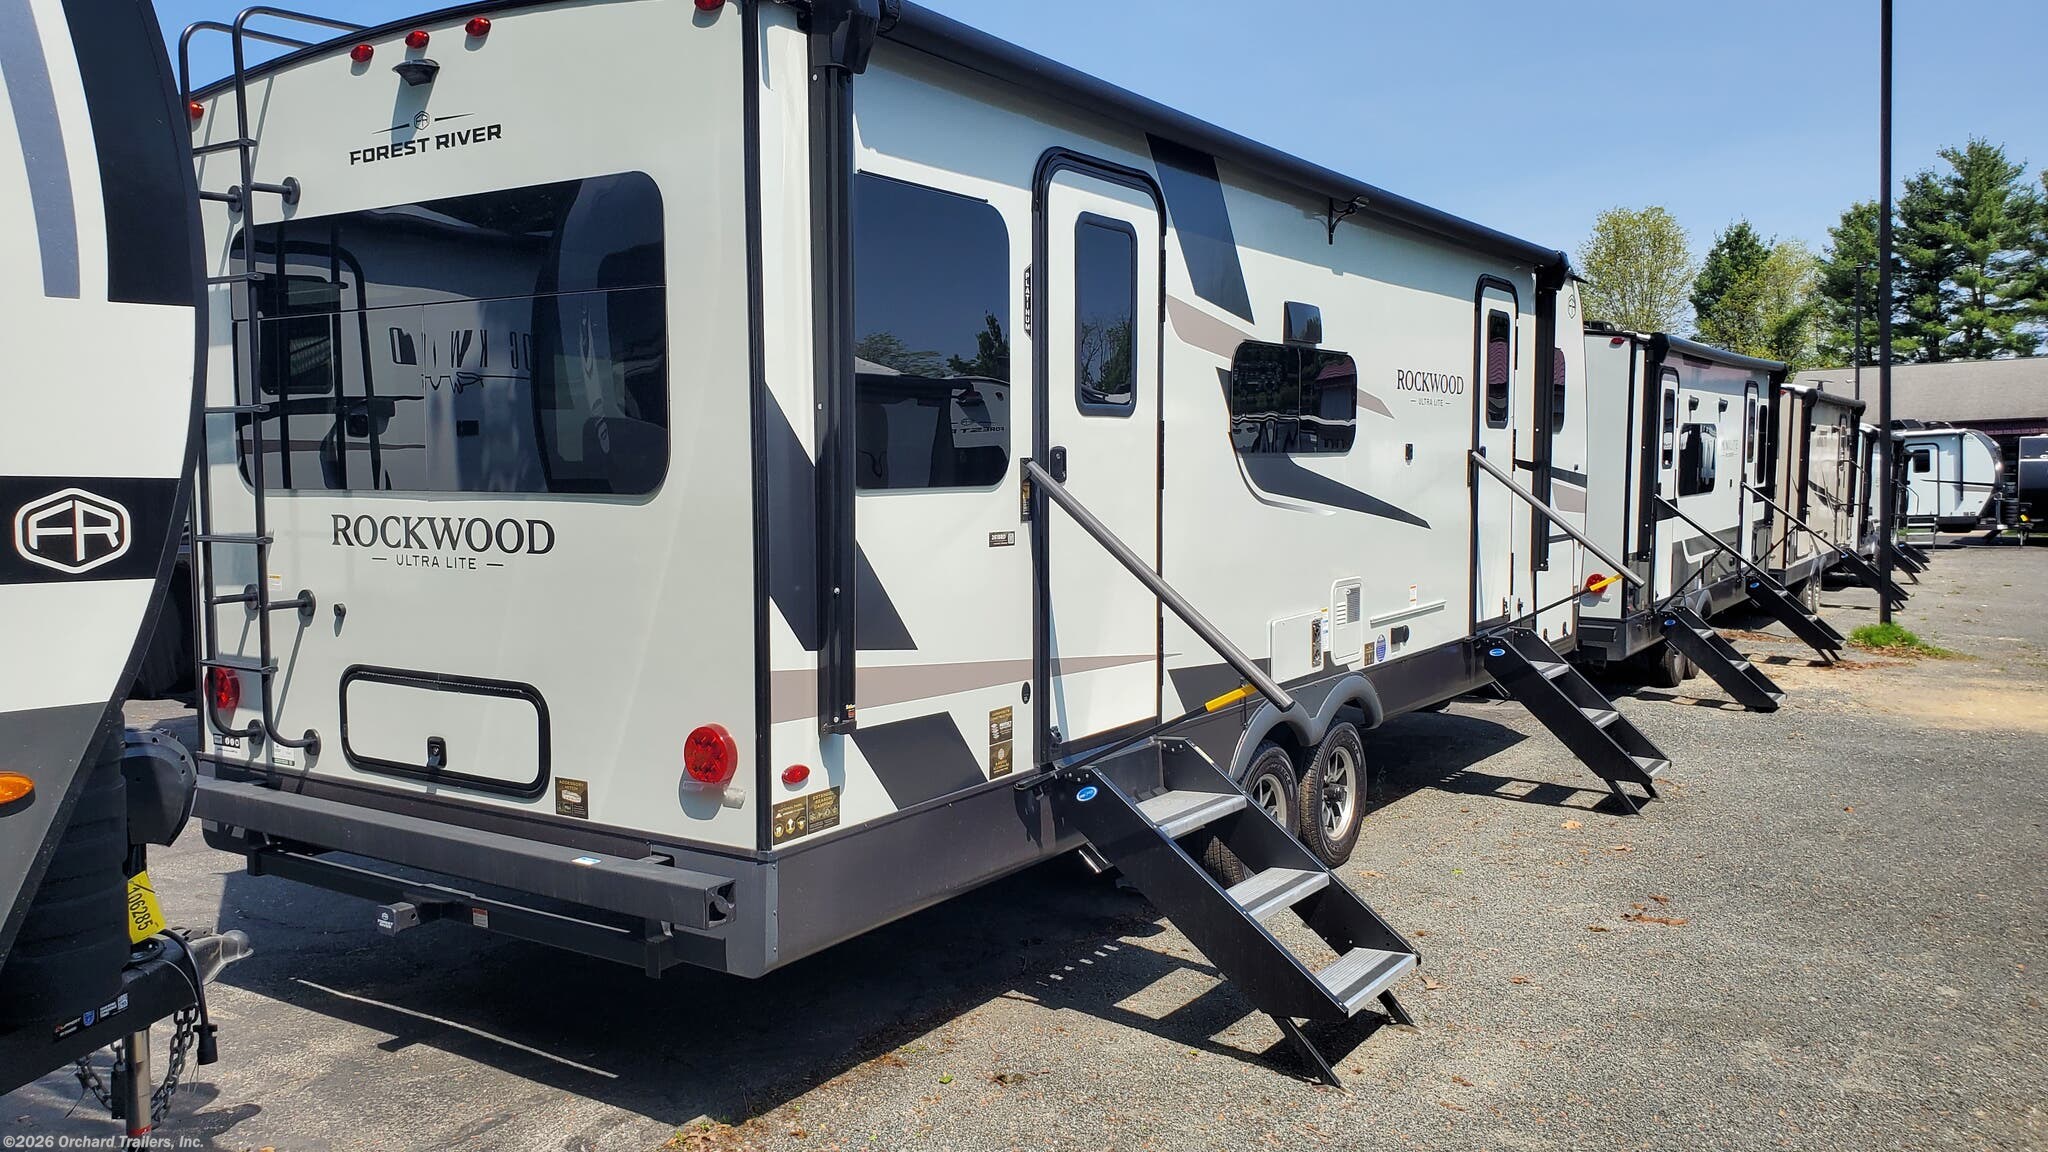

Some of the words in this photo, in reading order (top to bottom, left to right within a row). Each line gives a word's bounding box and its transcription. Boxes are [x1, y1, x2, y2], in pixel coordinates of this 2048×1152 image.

[349, 137, 430, 166] FOREST
[435, 123, 502, 150] RIVER
[1396, 369, 1464, 395] ROCKWOOD
[331, 514, 555, 555] ROCKWOOD
[396, 554, 440, 568] ULTRA
[446, 557, 477, 570] LITE
[127, 886, 153, 931] 106285
